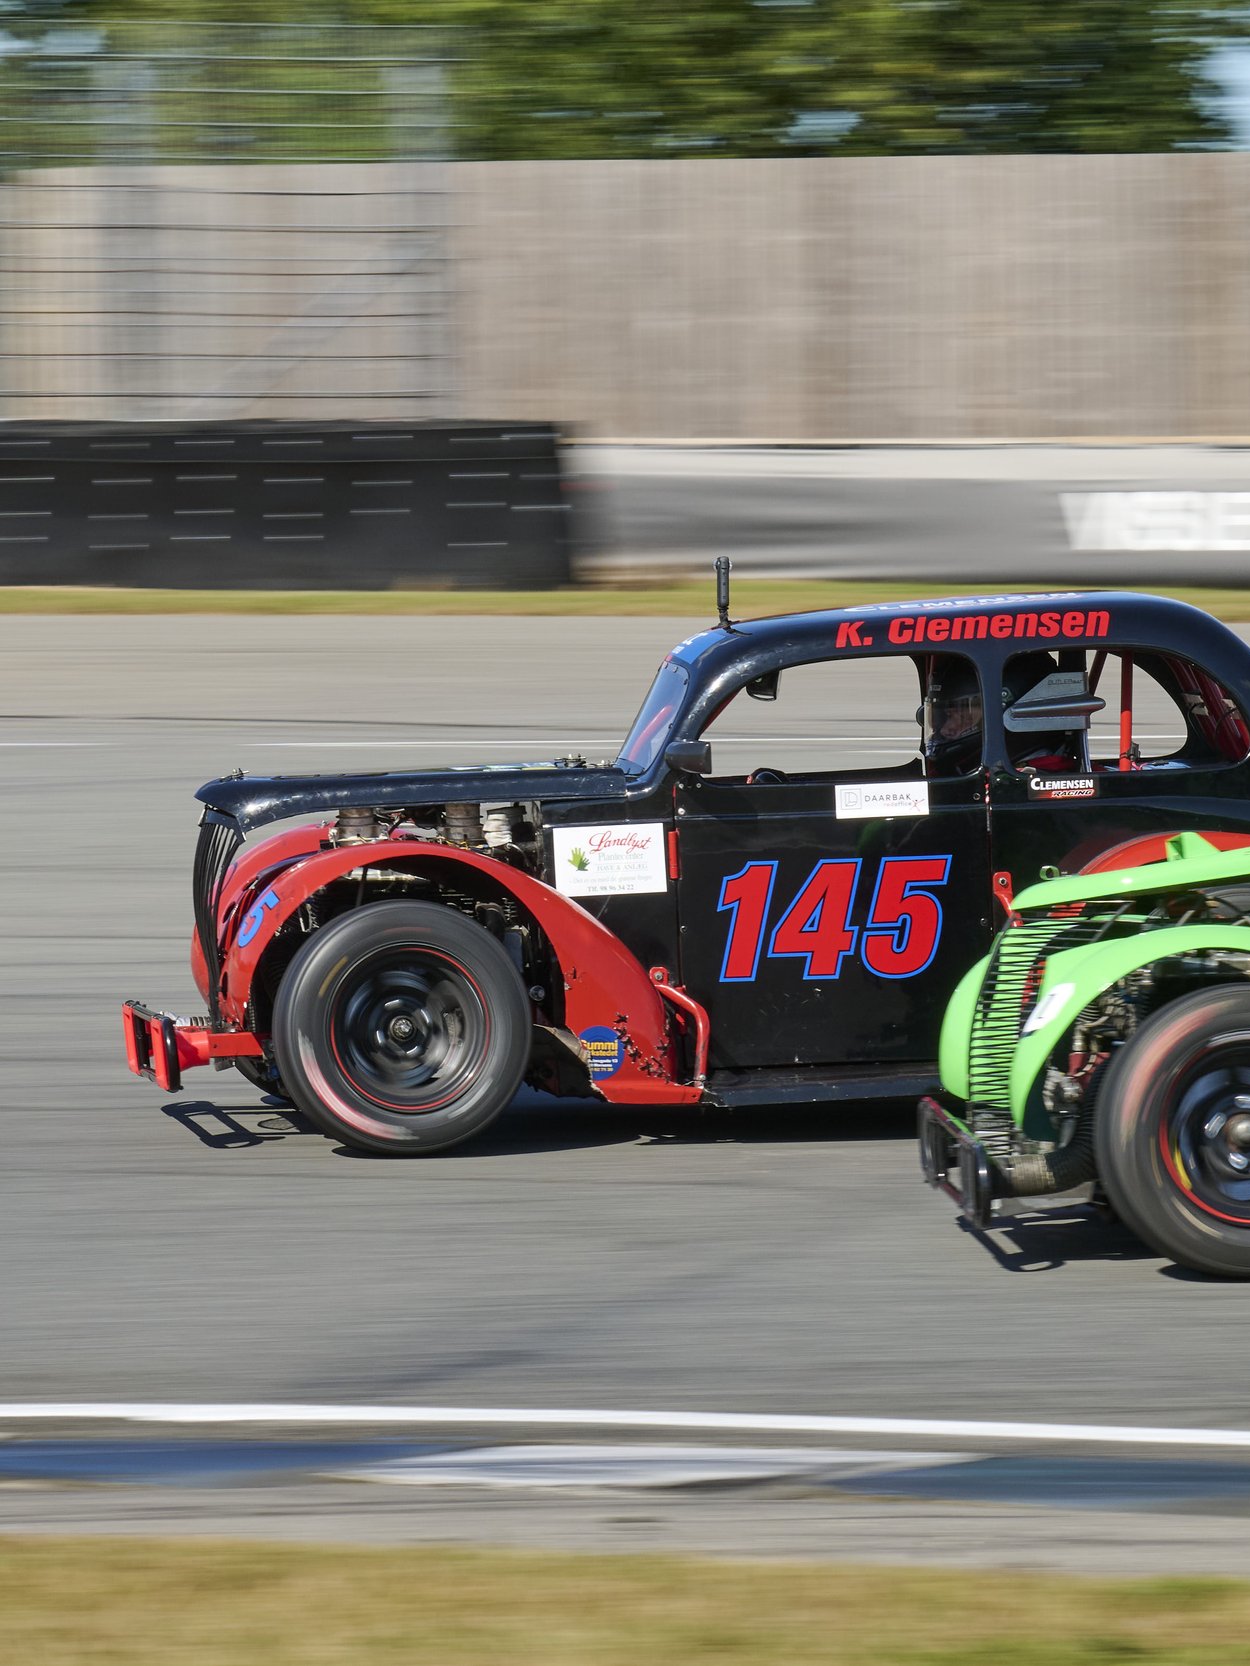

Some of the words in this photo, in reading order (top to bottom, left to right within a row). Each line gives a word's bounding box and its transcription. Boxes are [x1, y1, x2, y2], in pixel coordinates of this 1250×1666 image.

[835, 621, 873, 648] K.
[888, 610, 1111, 645] Clemensen
[1030, 777, 1094, 791] CLEMENSEN
[1051, 788, 1095, 798] RACING
[864, 793, 912, 803] DAARBAK
[588, 831, 652, 854] Landlyst
[717, 854, 953, 982] 145
